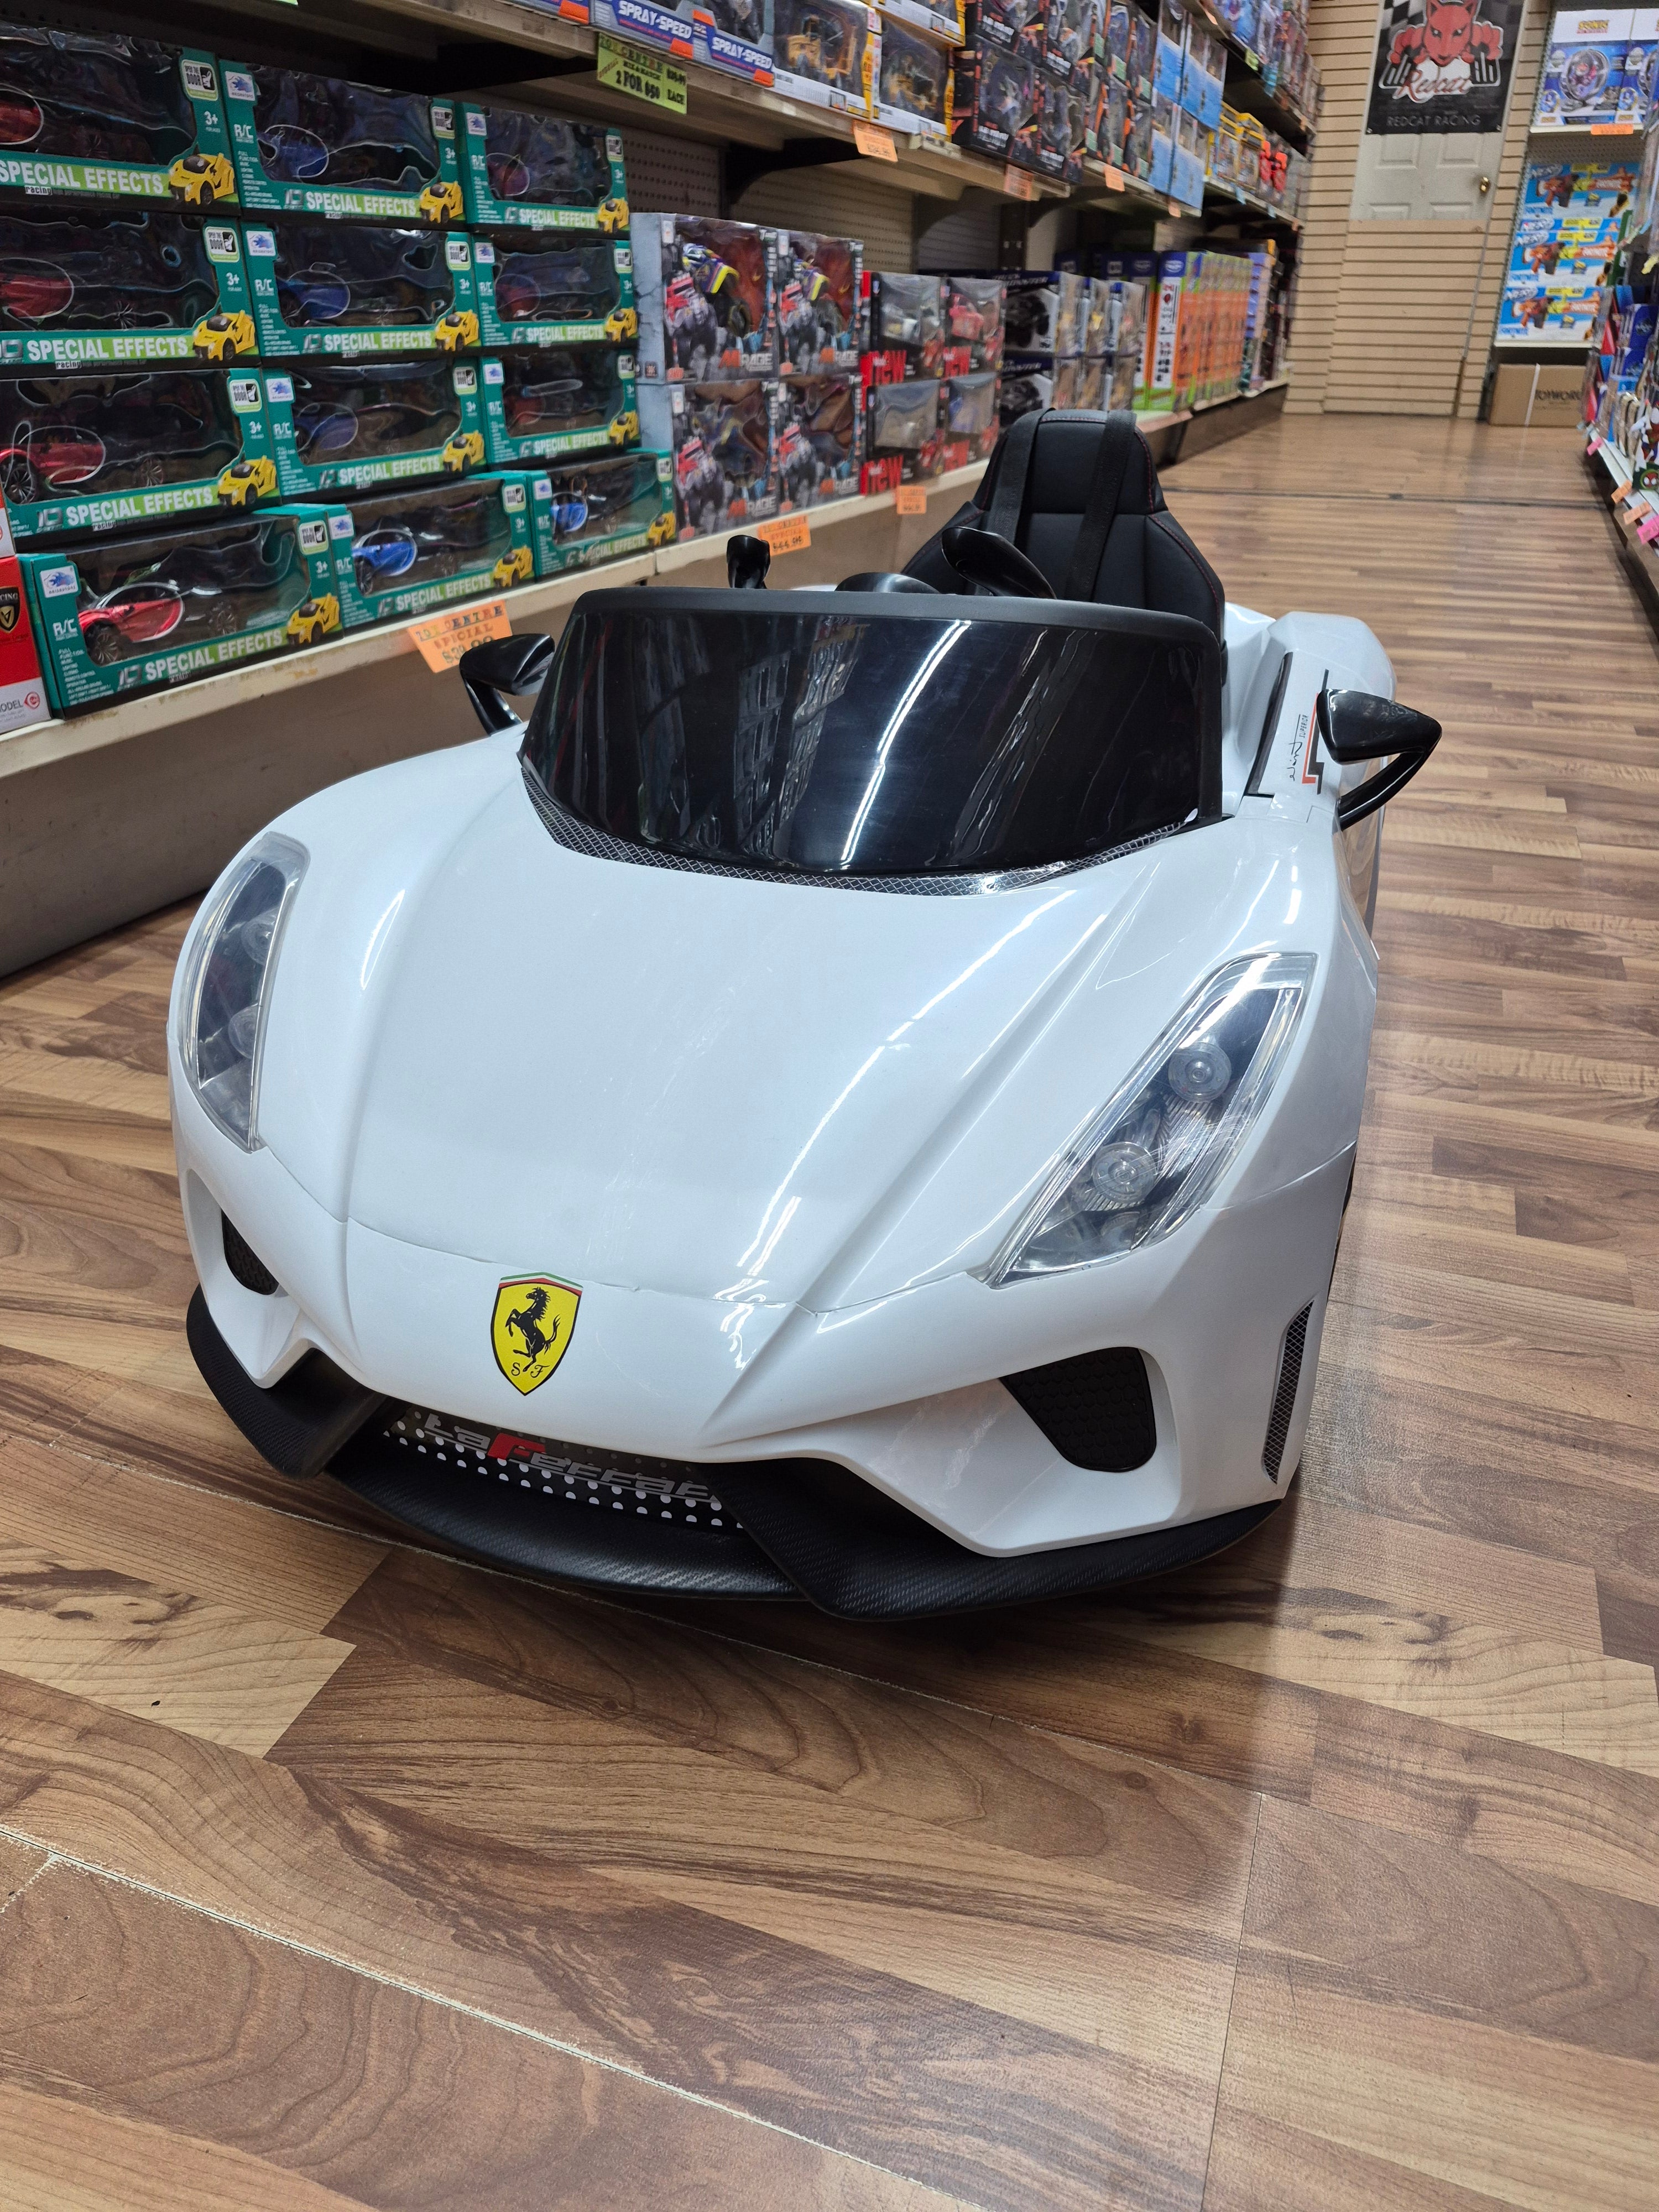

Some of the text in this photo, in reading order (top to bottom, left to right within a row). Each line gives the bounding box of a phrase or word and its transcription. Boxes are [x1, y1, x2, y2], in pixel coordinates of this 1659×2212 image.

[618, 2, 692, 39] SPRAY-SPEED
[712, 37, 772, 69] SPRAY-SPEED
[204, 111, 218, 125] 3+
[1386, 114, 1481, 127] REDCAT RACING
[234, 124, 253, 138] R/C
[0, 160, 164, 194] SPECIAL EFFECTS
[25, 186, 52, 195] racing
[306, 191, 416, 216] SPECIAL EFFECTS
[519, 208, 596, 228] SPECIAL EFFECTS
[226, 272, 239, 285] 3+
[254, 279, 274, 291] R/C
[324, 332, 432, 351] SPECIAL EFFECTS
[526, 325, 604, 342] SPECIAL EFFECTS
[28, 337, 188, 361] SPECIAL EFFECTS
[56, 361, 82, 370] racing
[249, 421, 262, 434] 3+
[273, 422, 292, 435] R/C
[533, 436, 571, 455] SPECIAL
[572, 430, 608, 449] EFFECTS
[338, 462, 390, 485] SPECIAL
[392, 455, 440, 476] EFFECTS
[66, 498, 140, 526] SPECIAL
[144, 486, 214, 514] EFFECTS
[92, 519, 117, 532] racing
[614, 533, 648, 551] EFFECTS
[316, 560, 328, 573] 3+
[395, 573, 491, 612] SPECIAL EFFECTS
[53, 618, 77, 635] R/C
[145, 628, 283, 681] SPECIAL EFFECTS
[1299, 714, 1308, 738] SUPERIOR
[510, 1361, 550, 1378] S F
[424, 1413, 721, 1504] LaFerrar
